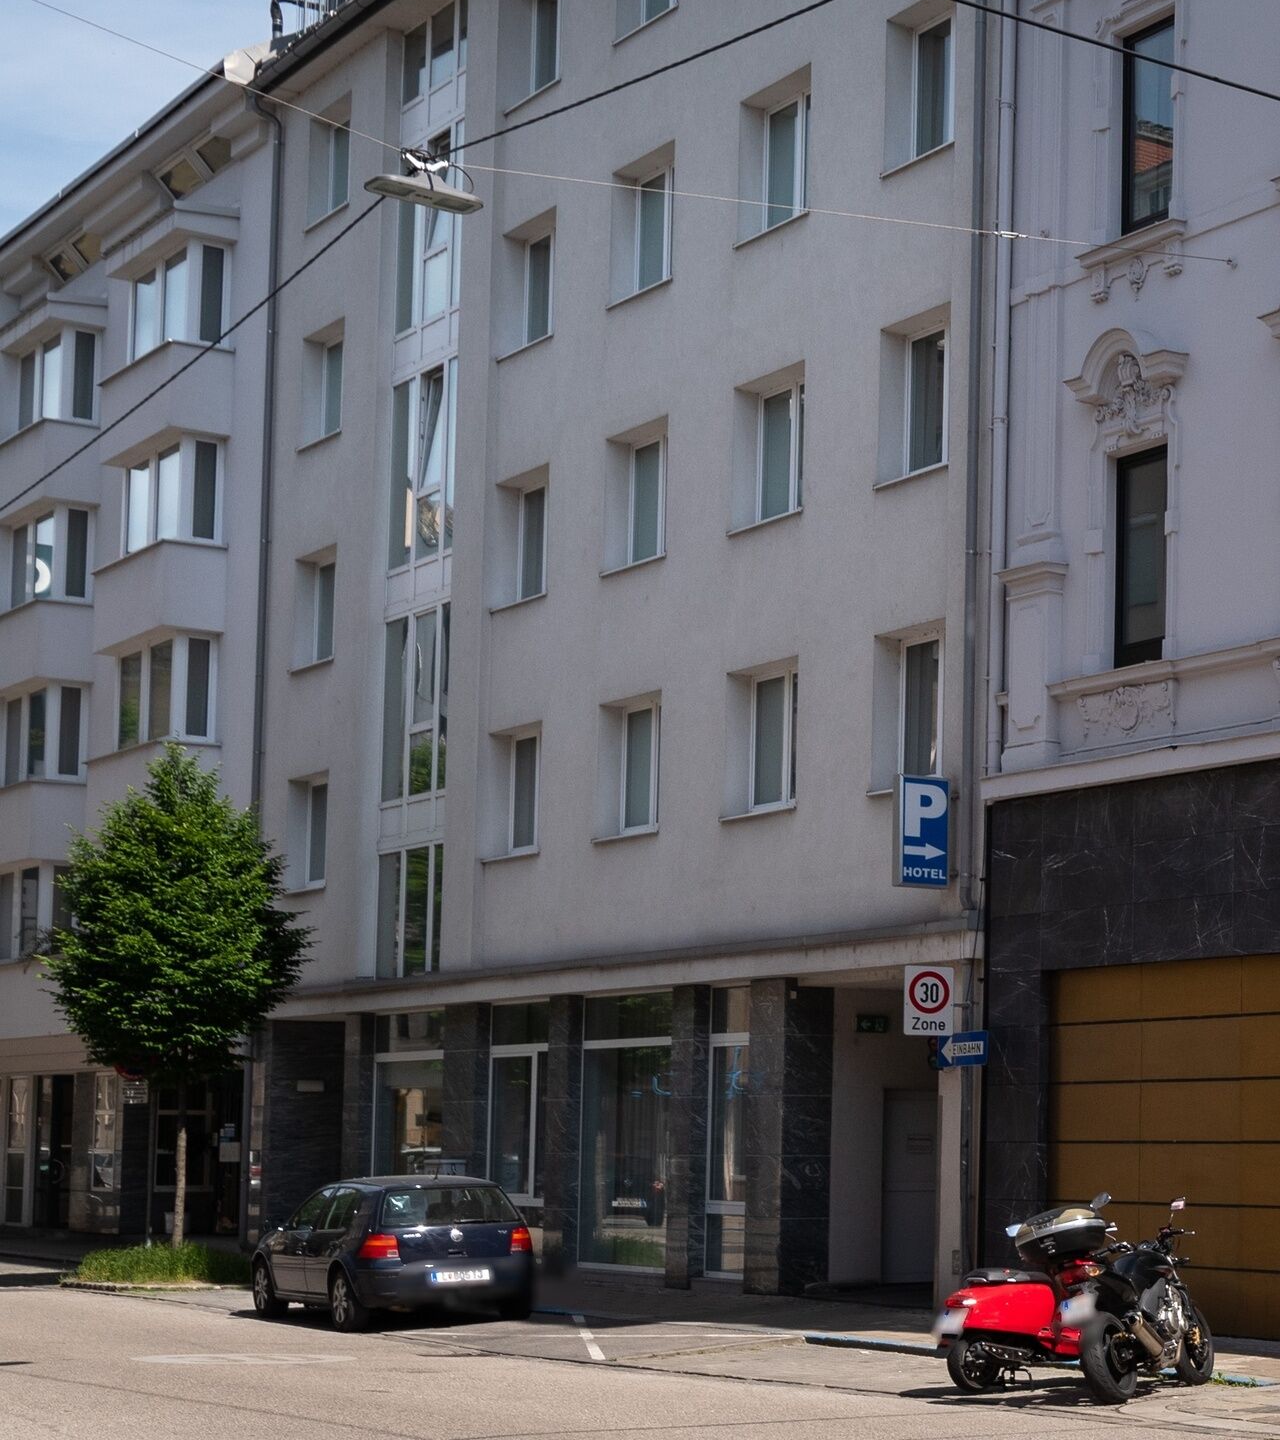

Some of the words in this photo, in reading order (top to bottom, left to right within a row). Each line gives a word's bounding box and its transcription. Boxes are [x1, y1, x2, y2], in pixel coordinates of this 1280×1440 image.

[904, 782, 947, 837] P
[903, 866, 946, 879] HOTEL
[920, 982, 939, 1003] 30
[912, 1017, 946, 1031] Zone
[953, 1042, 981, 1055] EINBAHN
